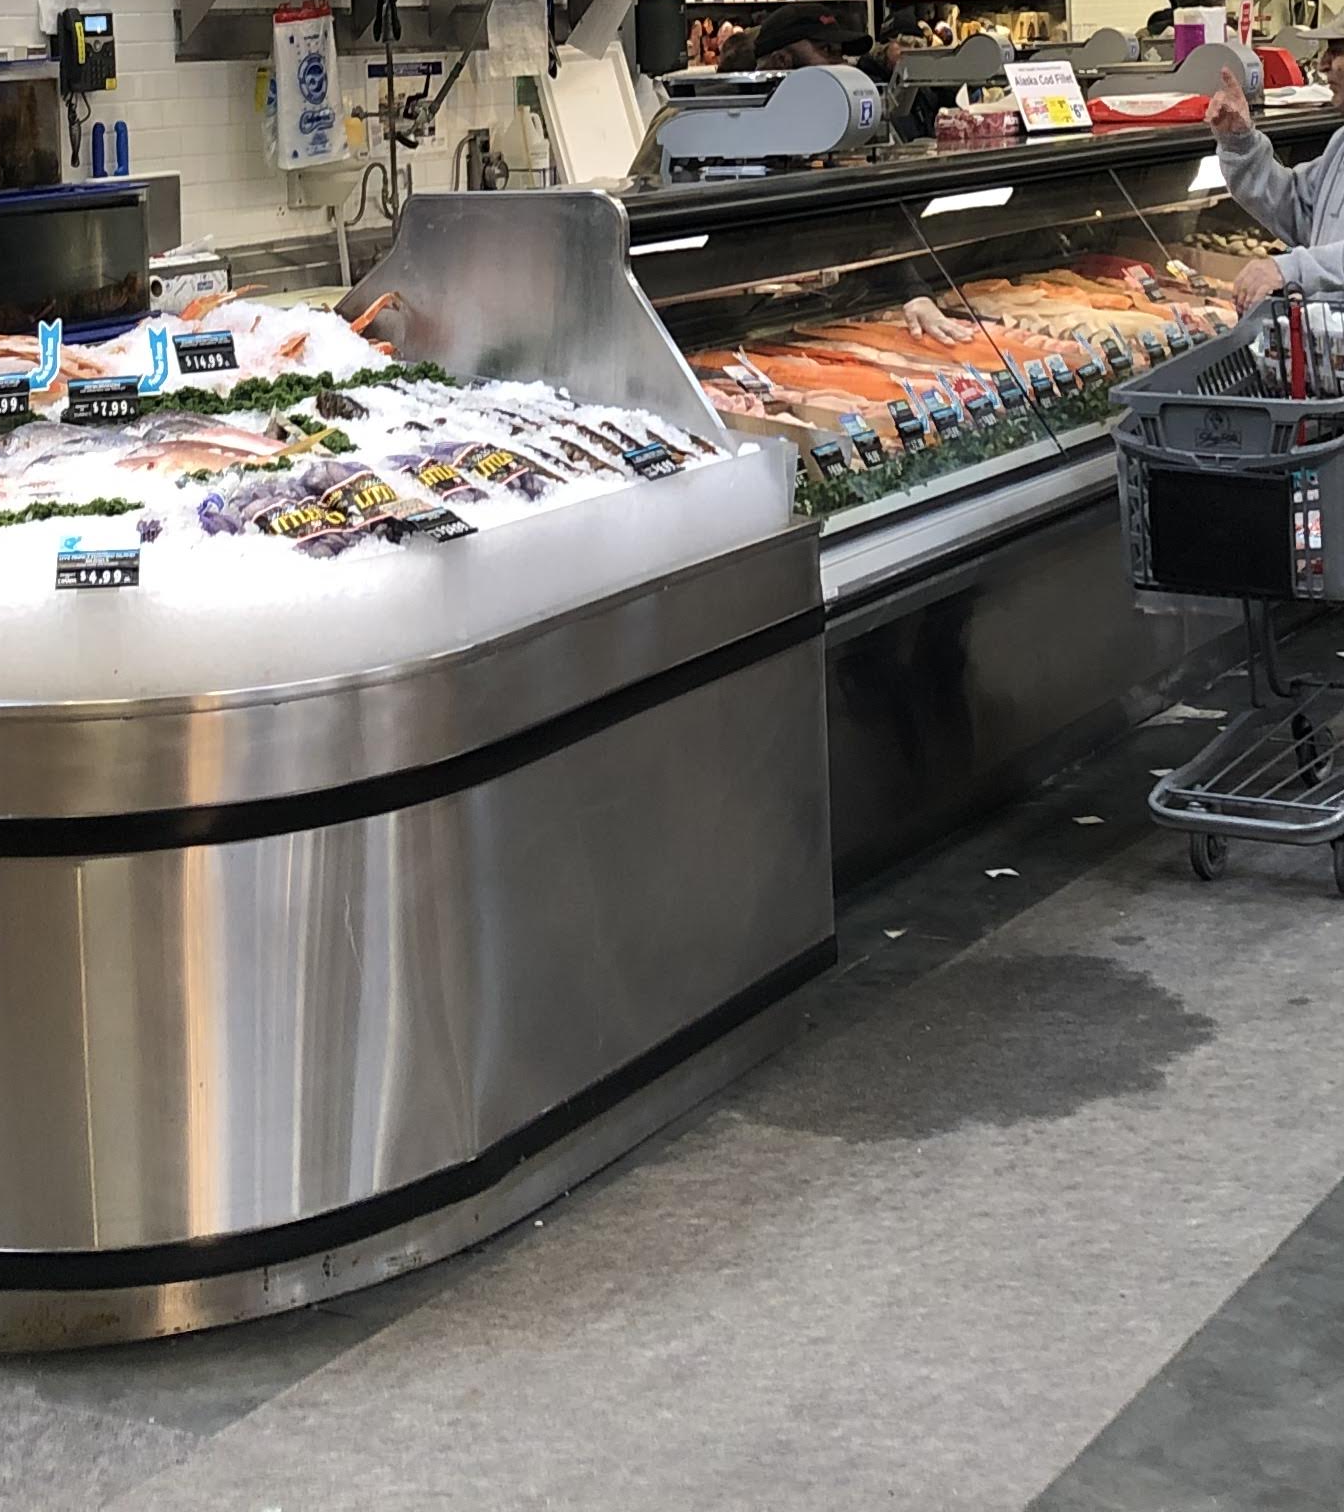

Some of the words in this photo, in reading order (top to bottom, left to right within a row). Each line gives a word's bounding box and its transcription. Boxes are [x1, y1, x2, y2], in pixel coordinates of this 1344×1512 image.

[1015, 73, 1038, 86] Alaska
[1039, 74, 1054, 86] Cod
[93, 399, 127, 416] $7.99
